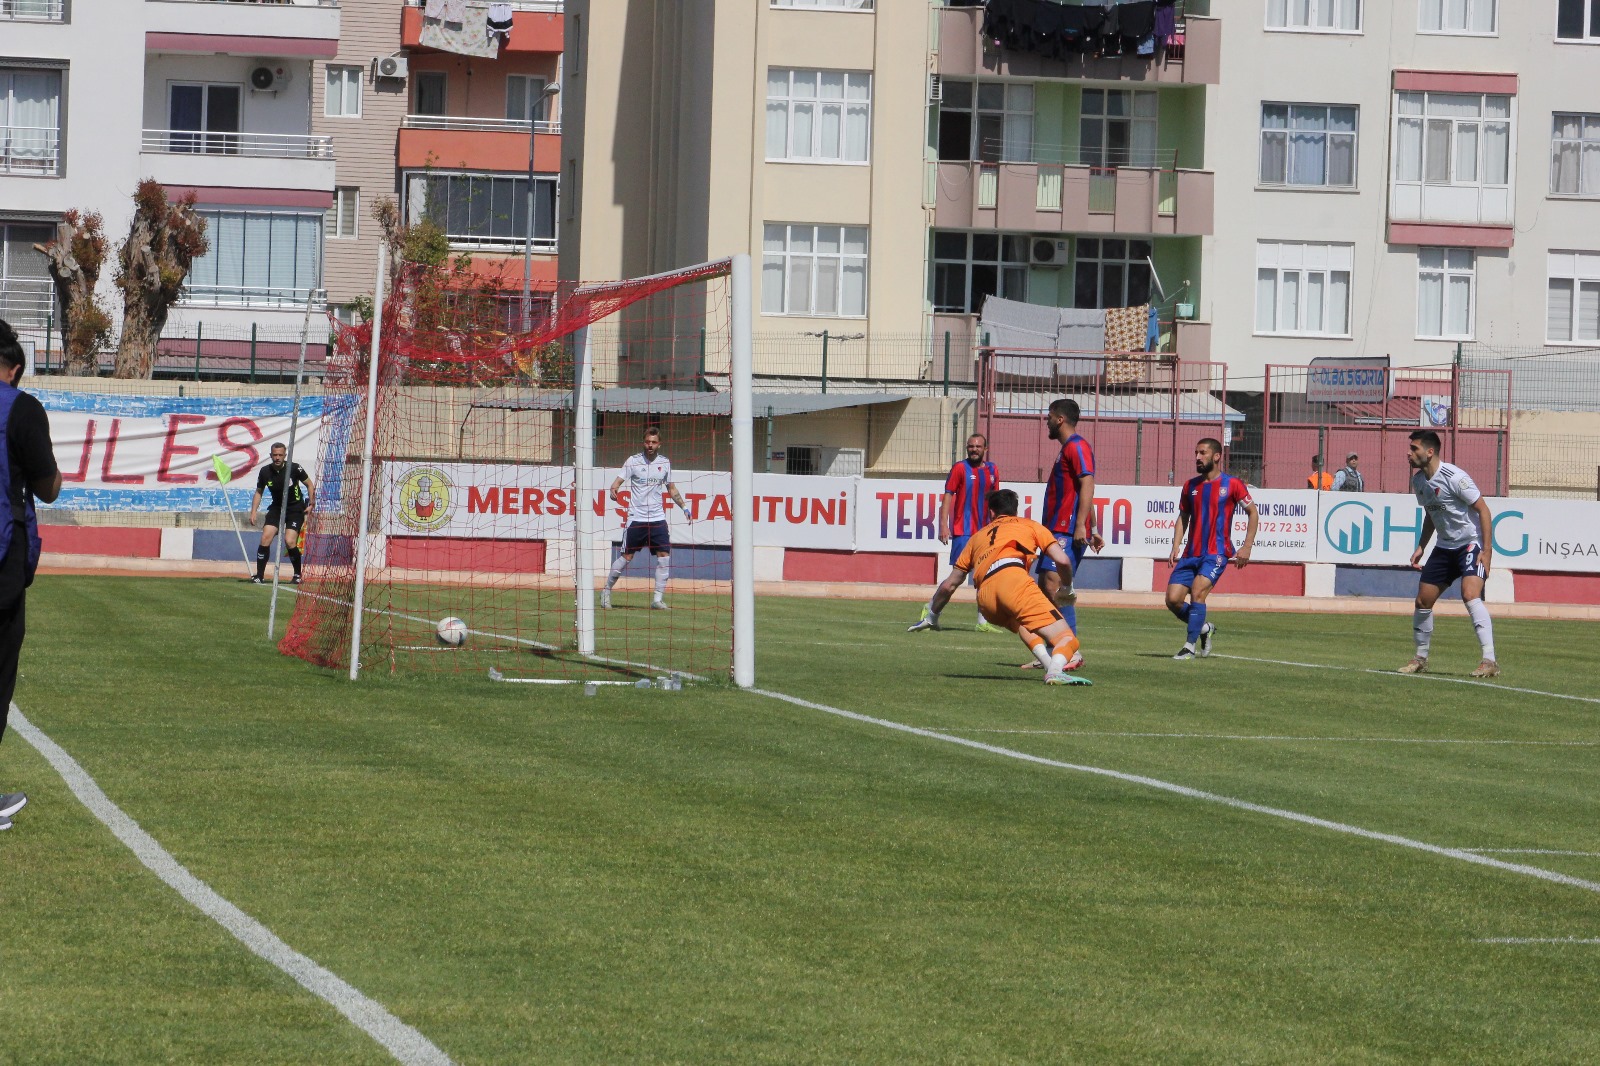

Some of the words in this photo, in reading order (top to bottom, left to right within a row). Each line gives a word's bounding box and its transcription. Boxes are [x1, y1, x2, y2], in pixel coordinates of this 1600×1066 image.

[615, 489, 674, 528] ŞF
[1146, 499, 1175, 514] DÖNER
[1273, 503, 1307, 517] SALONU
[1258, 522, 1276, 533] 172
[1279, 522, 1292, 533] 72
[1295, 523, 1308, 534] 33
[1144, 535, 1170, 545] SİLİFKE
[1465, 552, 1474, 566] 9
